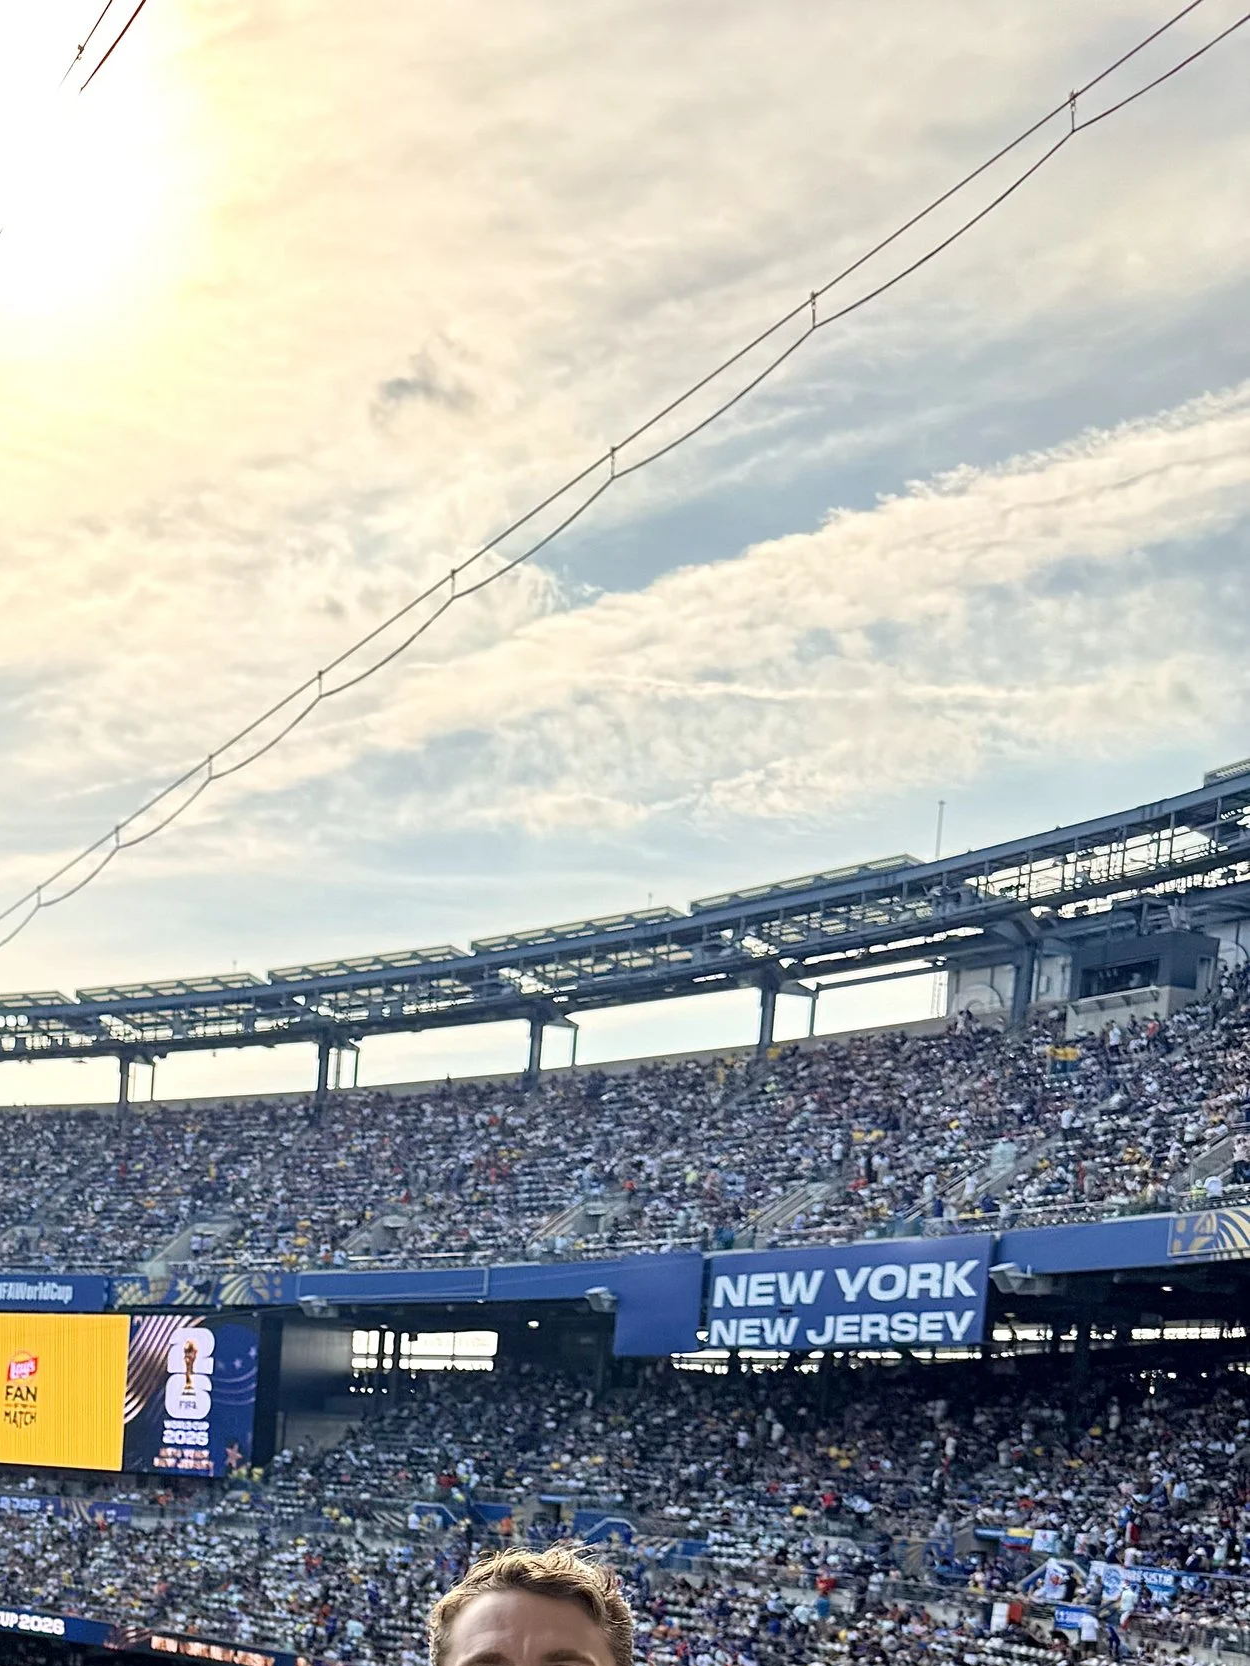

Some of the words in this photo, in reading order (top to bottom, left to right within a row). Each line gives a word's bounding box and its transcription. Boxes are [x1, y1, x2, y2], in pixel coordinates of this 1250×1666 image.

[713, 1268, 825, 1308] NEW
[834, 1259, 980, 1303] YORK
[709, 1315, 800, 1347] NEW
[806, 1309, 976, 1346] JERSEY
[4, 1384, 38, 1402] FAN
[3, 1410, 37, 1429] MATCH
[18, 1613, 66, 1636] 2026
